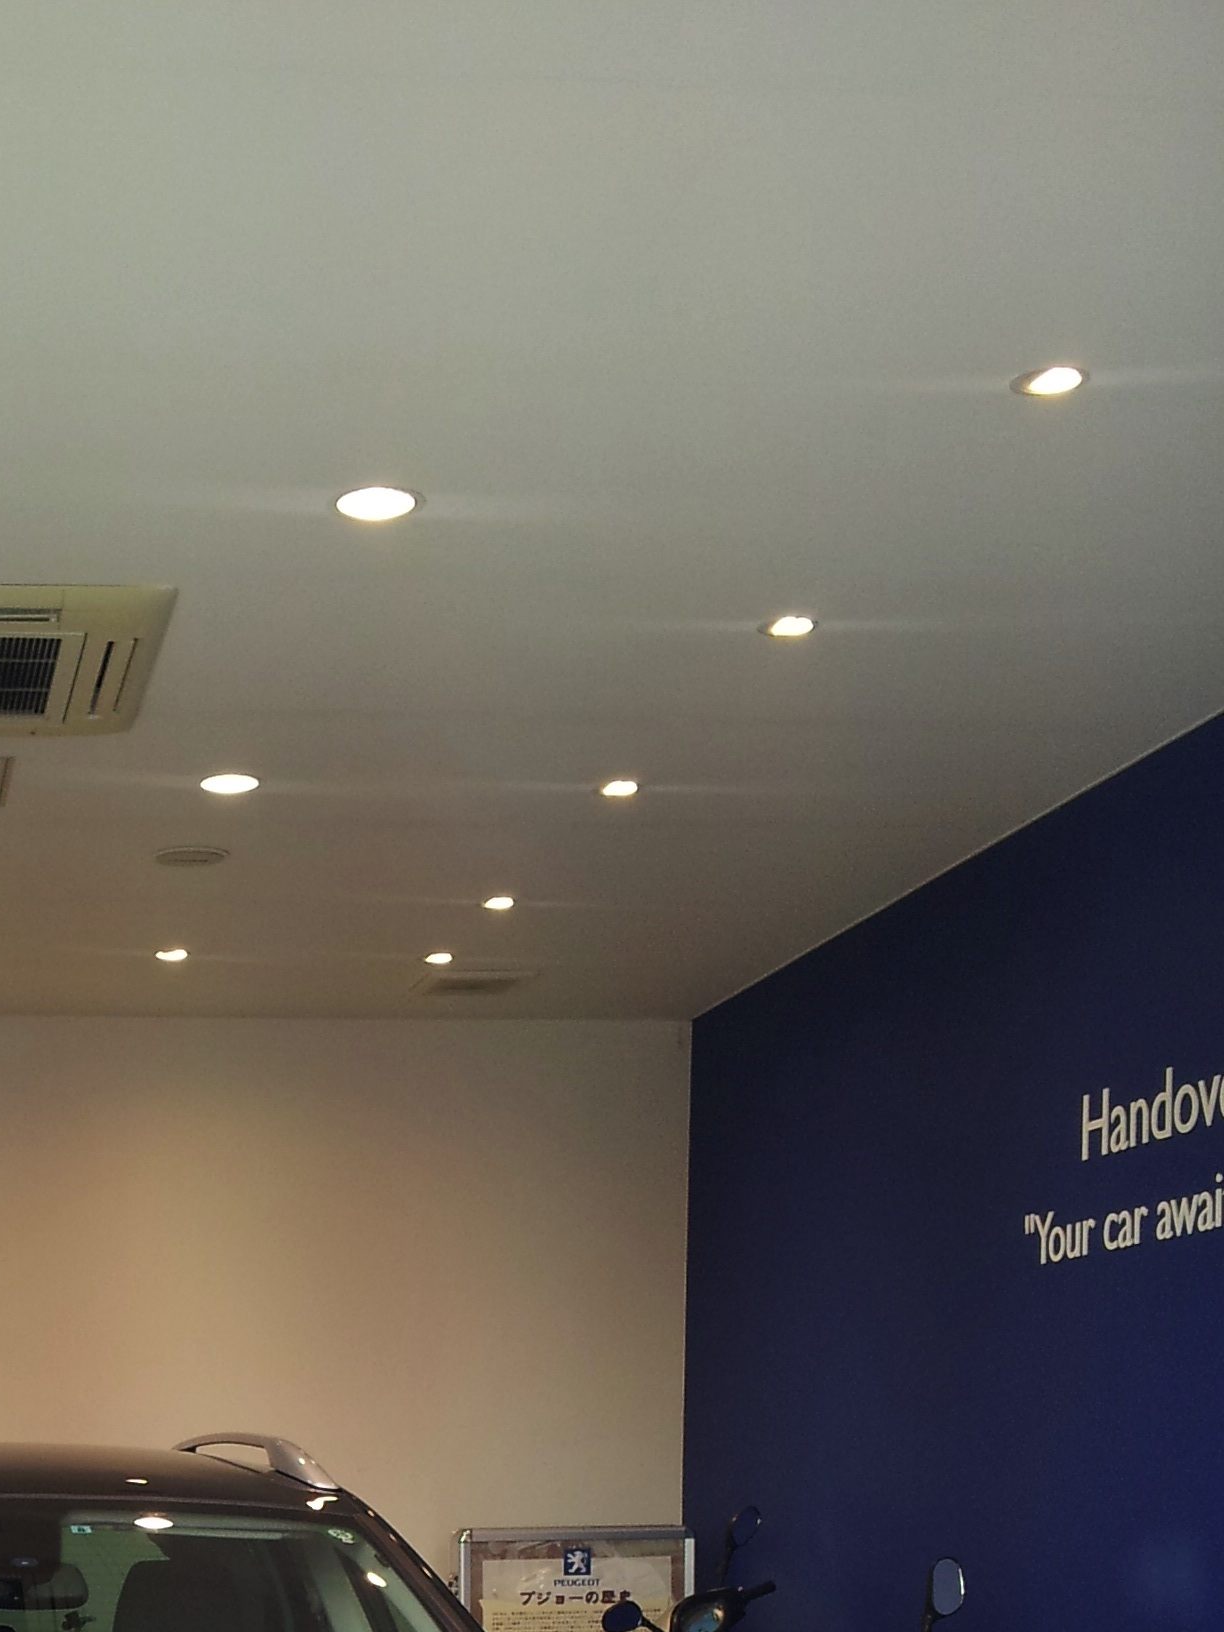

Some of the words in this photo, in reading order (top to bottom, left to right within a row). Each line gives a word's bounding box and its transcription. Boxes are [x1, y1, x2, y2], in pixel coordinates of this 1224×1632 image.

[1081, 1066, 1224, 1162] Handove
[1103, 1206, 1148, 1251] car
[1156, 1172, 1224, 1241] awai
[553, 1578, 600, 1587] PEUGEOT
